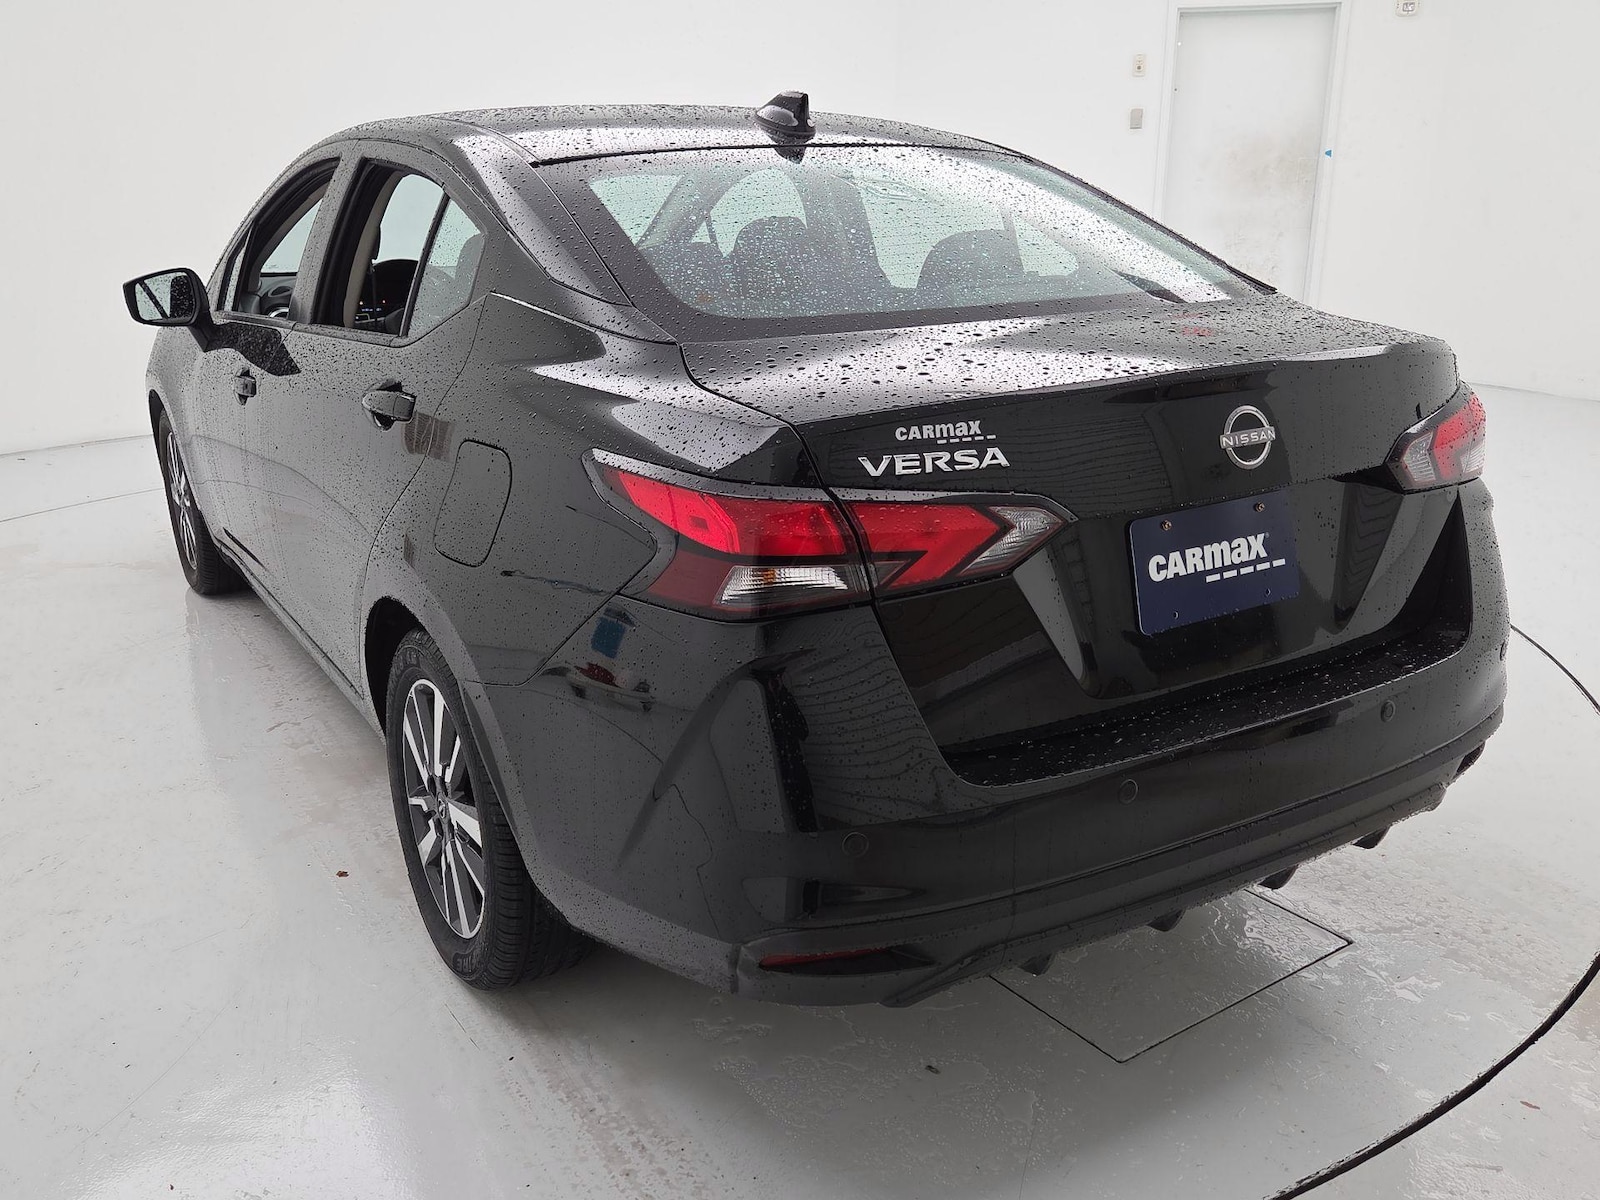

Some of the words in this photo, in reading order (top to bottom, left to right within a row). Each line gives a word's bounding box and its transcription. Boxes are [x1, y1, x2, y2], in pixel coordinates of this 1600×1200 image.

[895, 419, 982, 441] CARmax
[1222, 429, 1276, 447] NISSAN
[857, 446, 1011, 477] VERSA
[1148, 533, 1268, 583] CARmax
